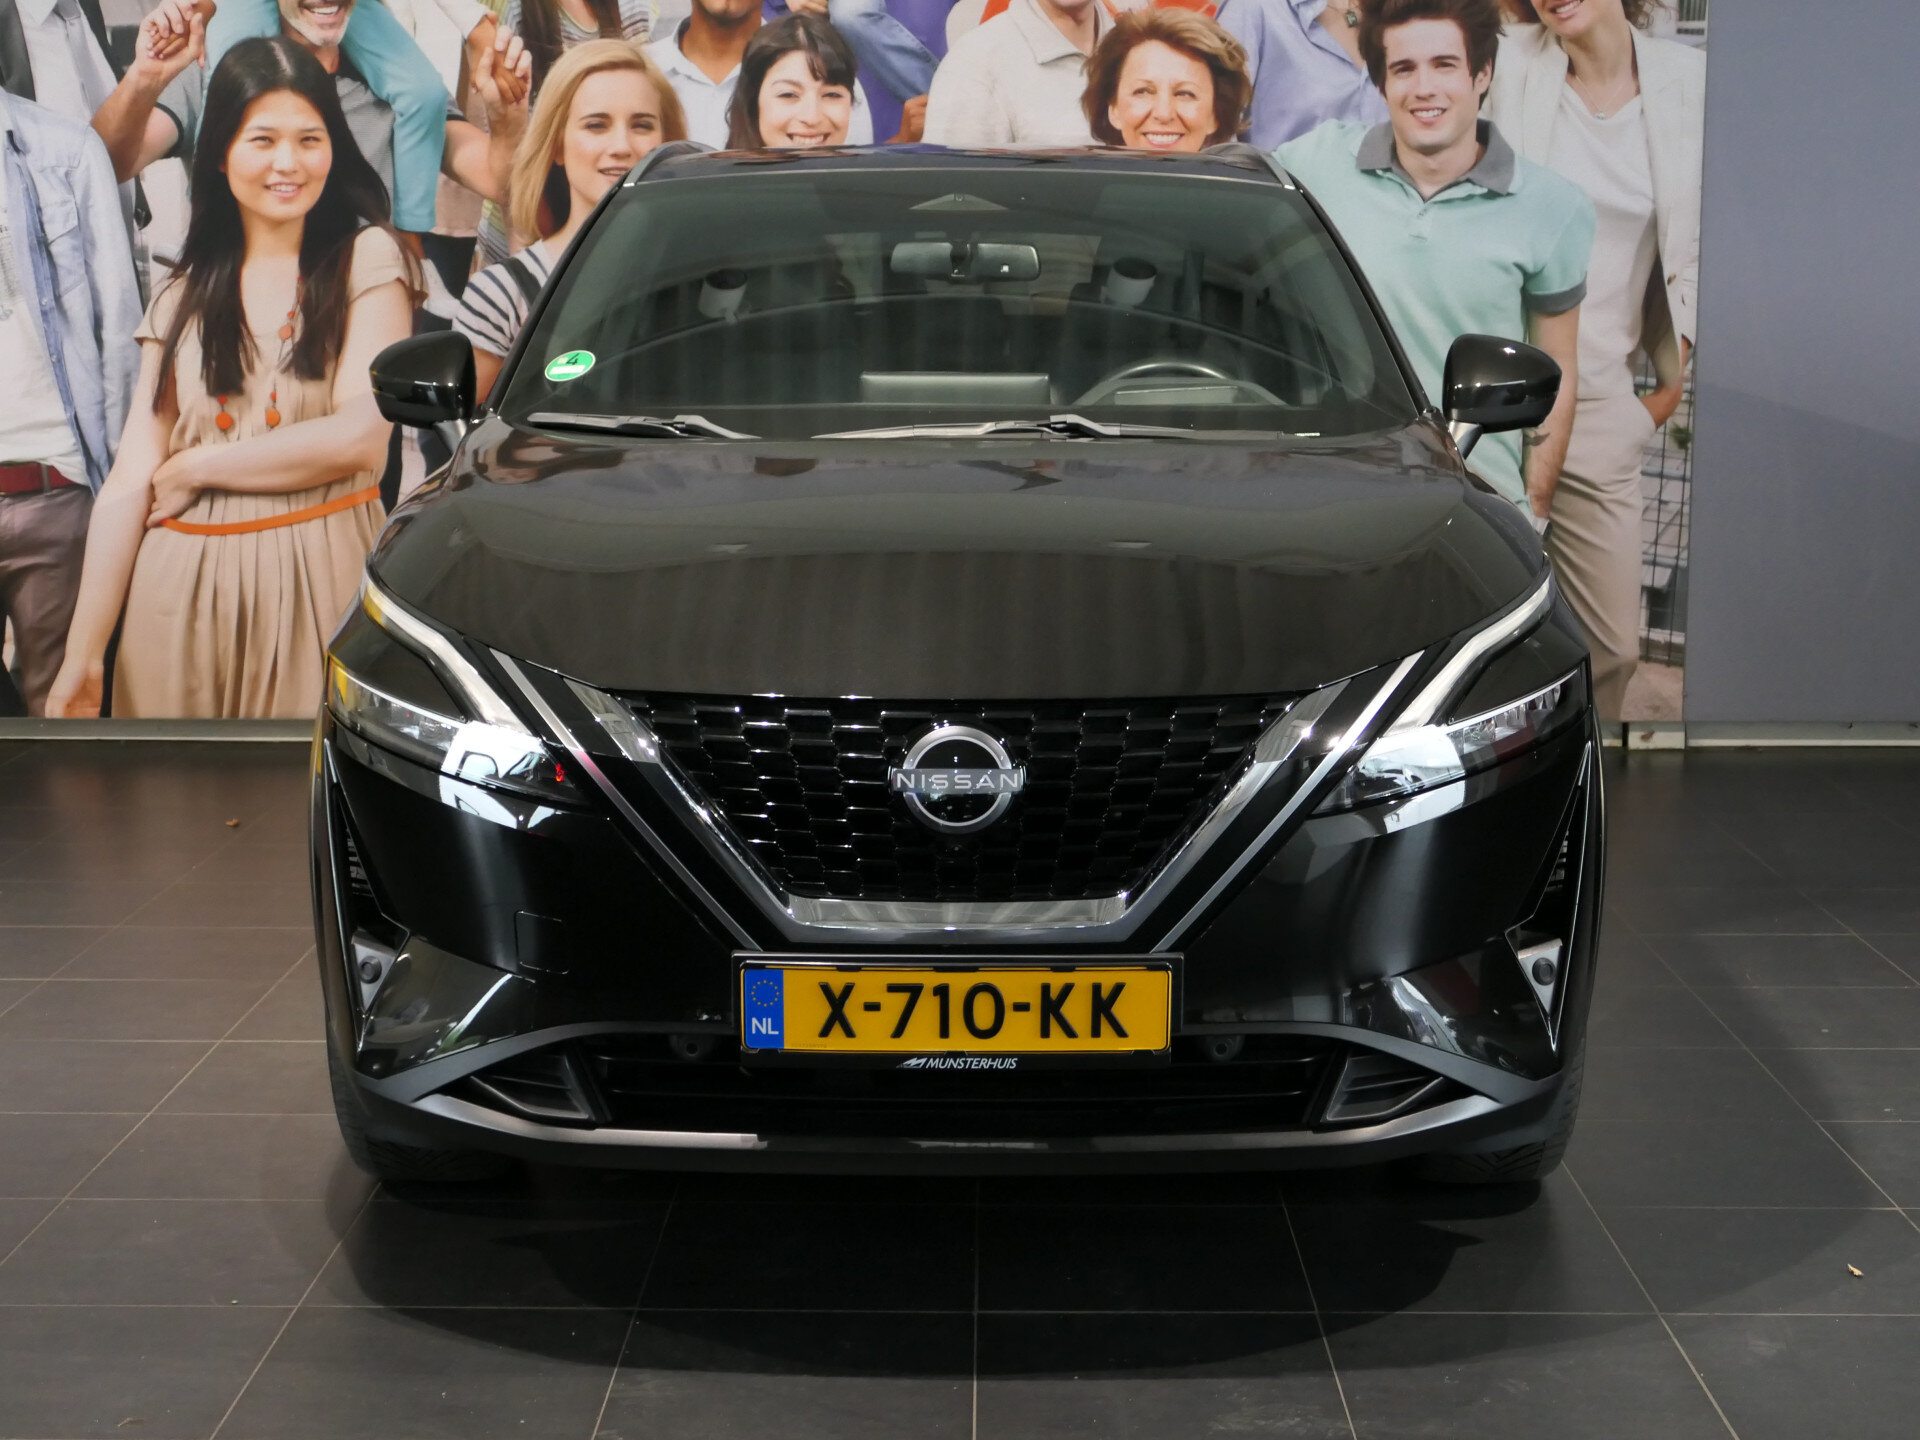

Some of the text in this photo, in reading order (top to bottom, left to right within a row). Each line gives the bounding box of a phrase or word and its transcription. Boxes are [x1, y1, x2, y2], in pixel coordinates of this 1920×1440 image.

[896, 773, 1018, 789] NISSAN
[818, 982, 1129, 1040] X-710-KK
[751, 1017, 779, 1035] NL
[926, 1057, 1018, 1069] MUNSTERHUIS
